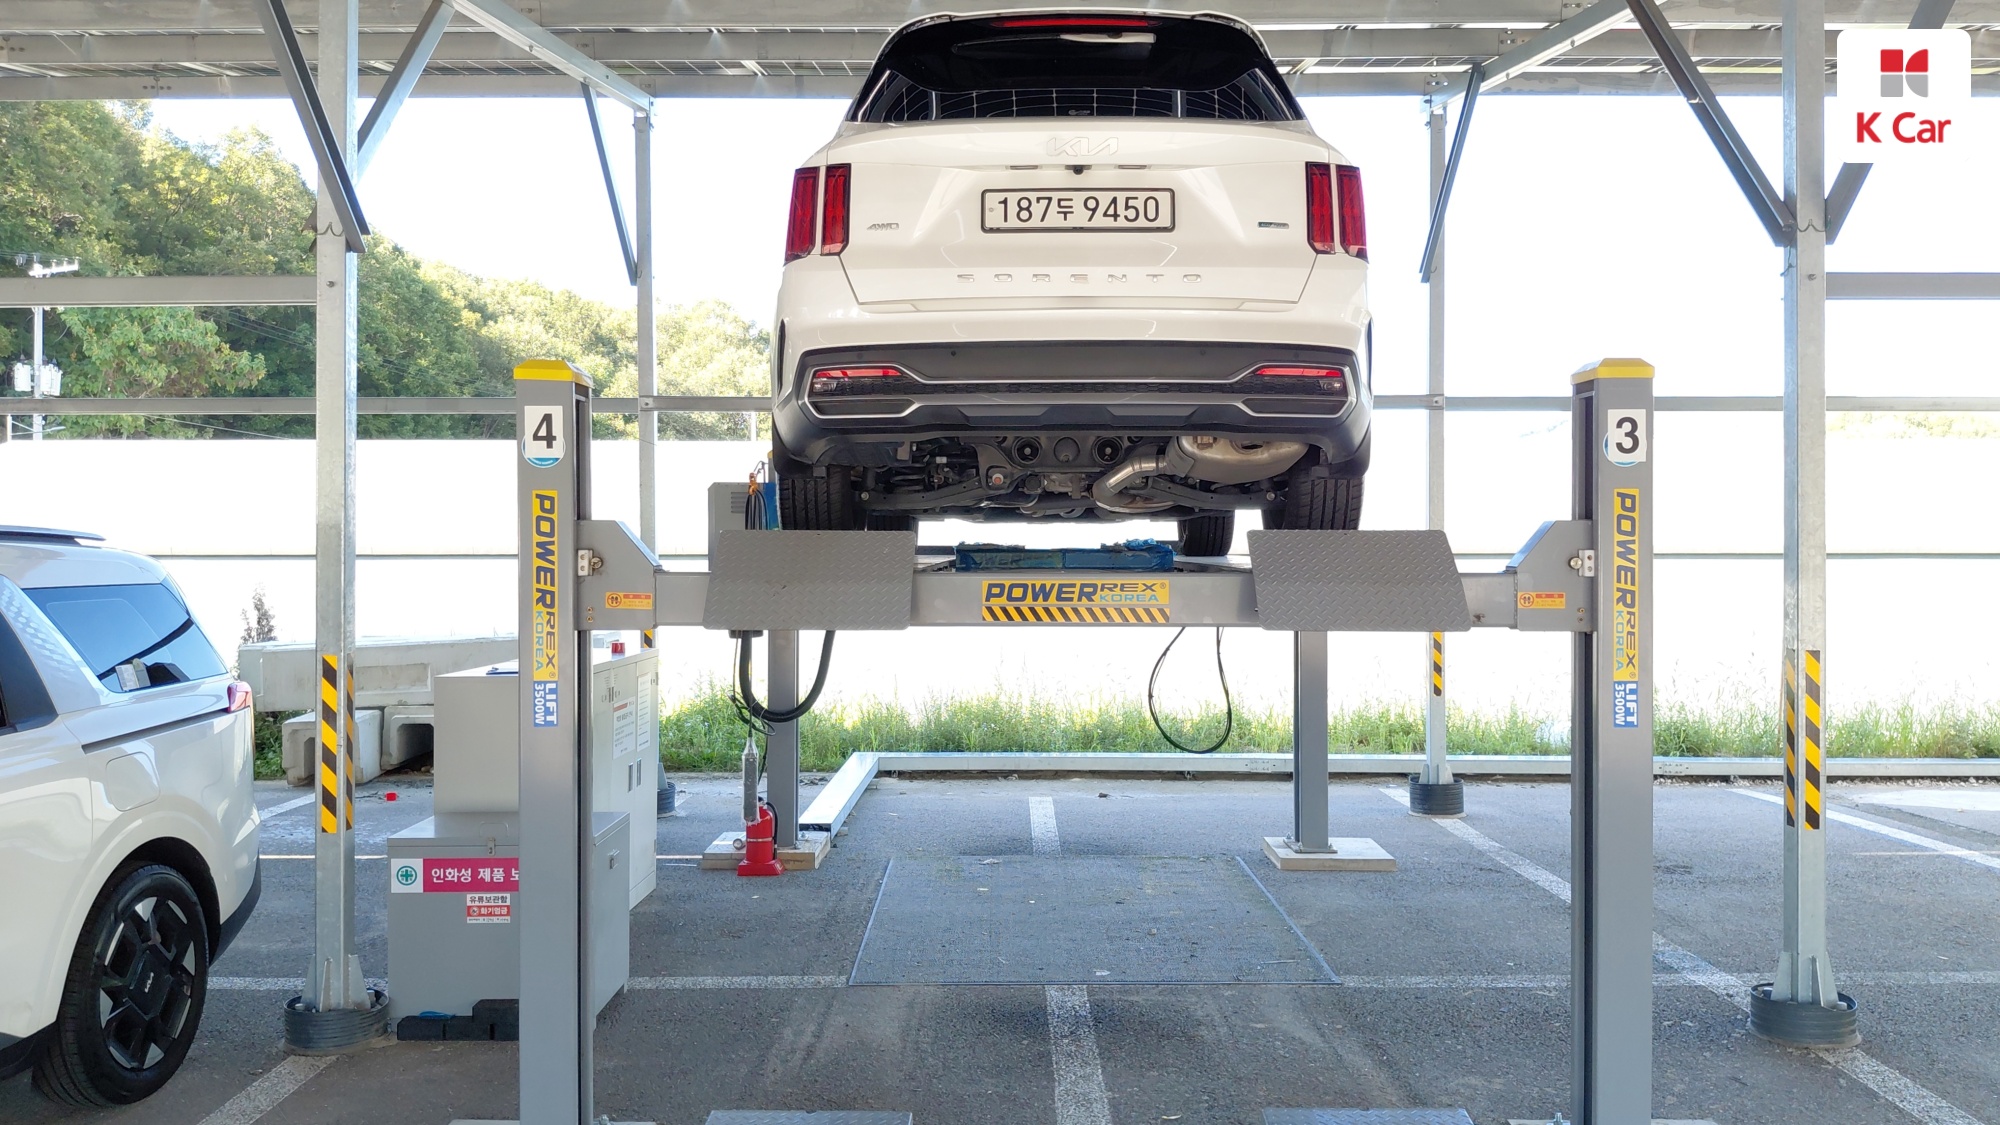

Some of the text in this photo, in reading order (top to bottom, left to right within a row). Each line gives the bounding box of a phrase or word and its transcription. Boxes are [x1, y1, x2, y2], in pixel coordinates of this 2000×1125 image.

[997, 195, 1160, 223] 187두 9450
[956, 272, 1202, 284] SORENTO
[532, 412, 557, 449] 4
[1615, 416, 1640, 455] 3
[1099, 593, 1160, 603] KOREA
[535, 610, 545, 672] KOREA
[1615, 610, 1625, 672] KOREA
[534, 683, 545, 725] 3500W
[545, 683, 557, 724] LIFT
[1614, 683, 1625, 726] 3500W
[1625, 683, 1637, 725] LIFT
[431, 867, 472, 883] 인화성
[477, 867, 506, 883] 제품
